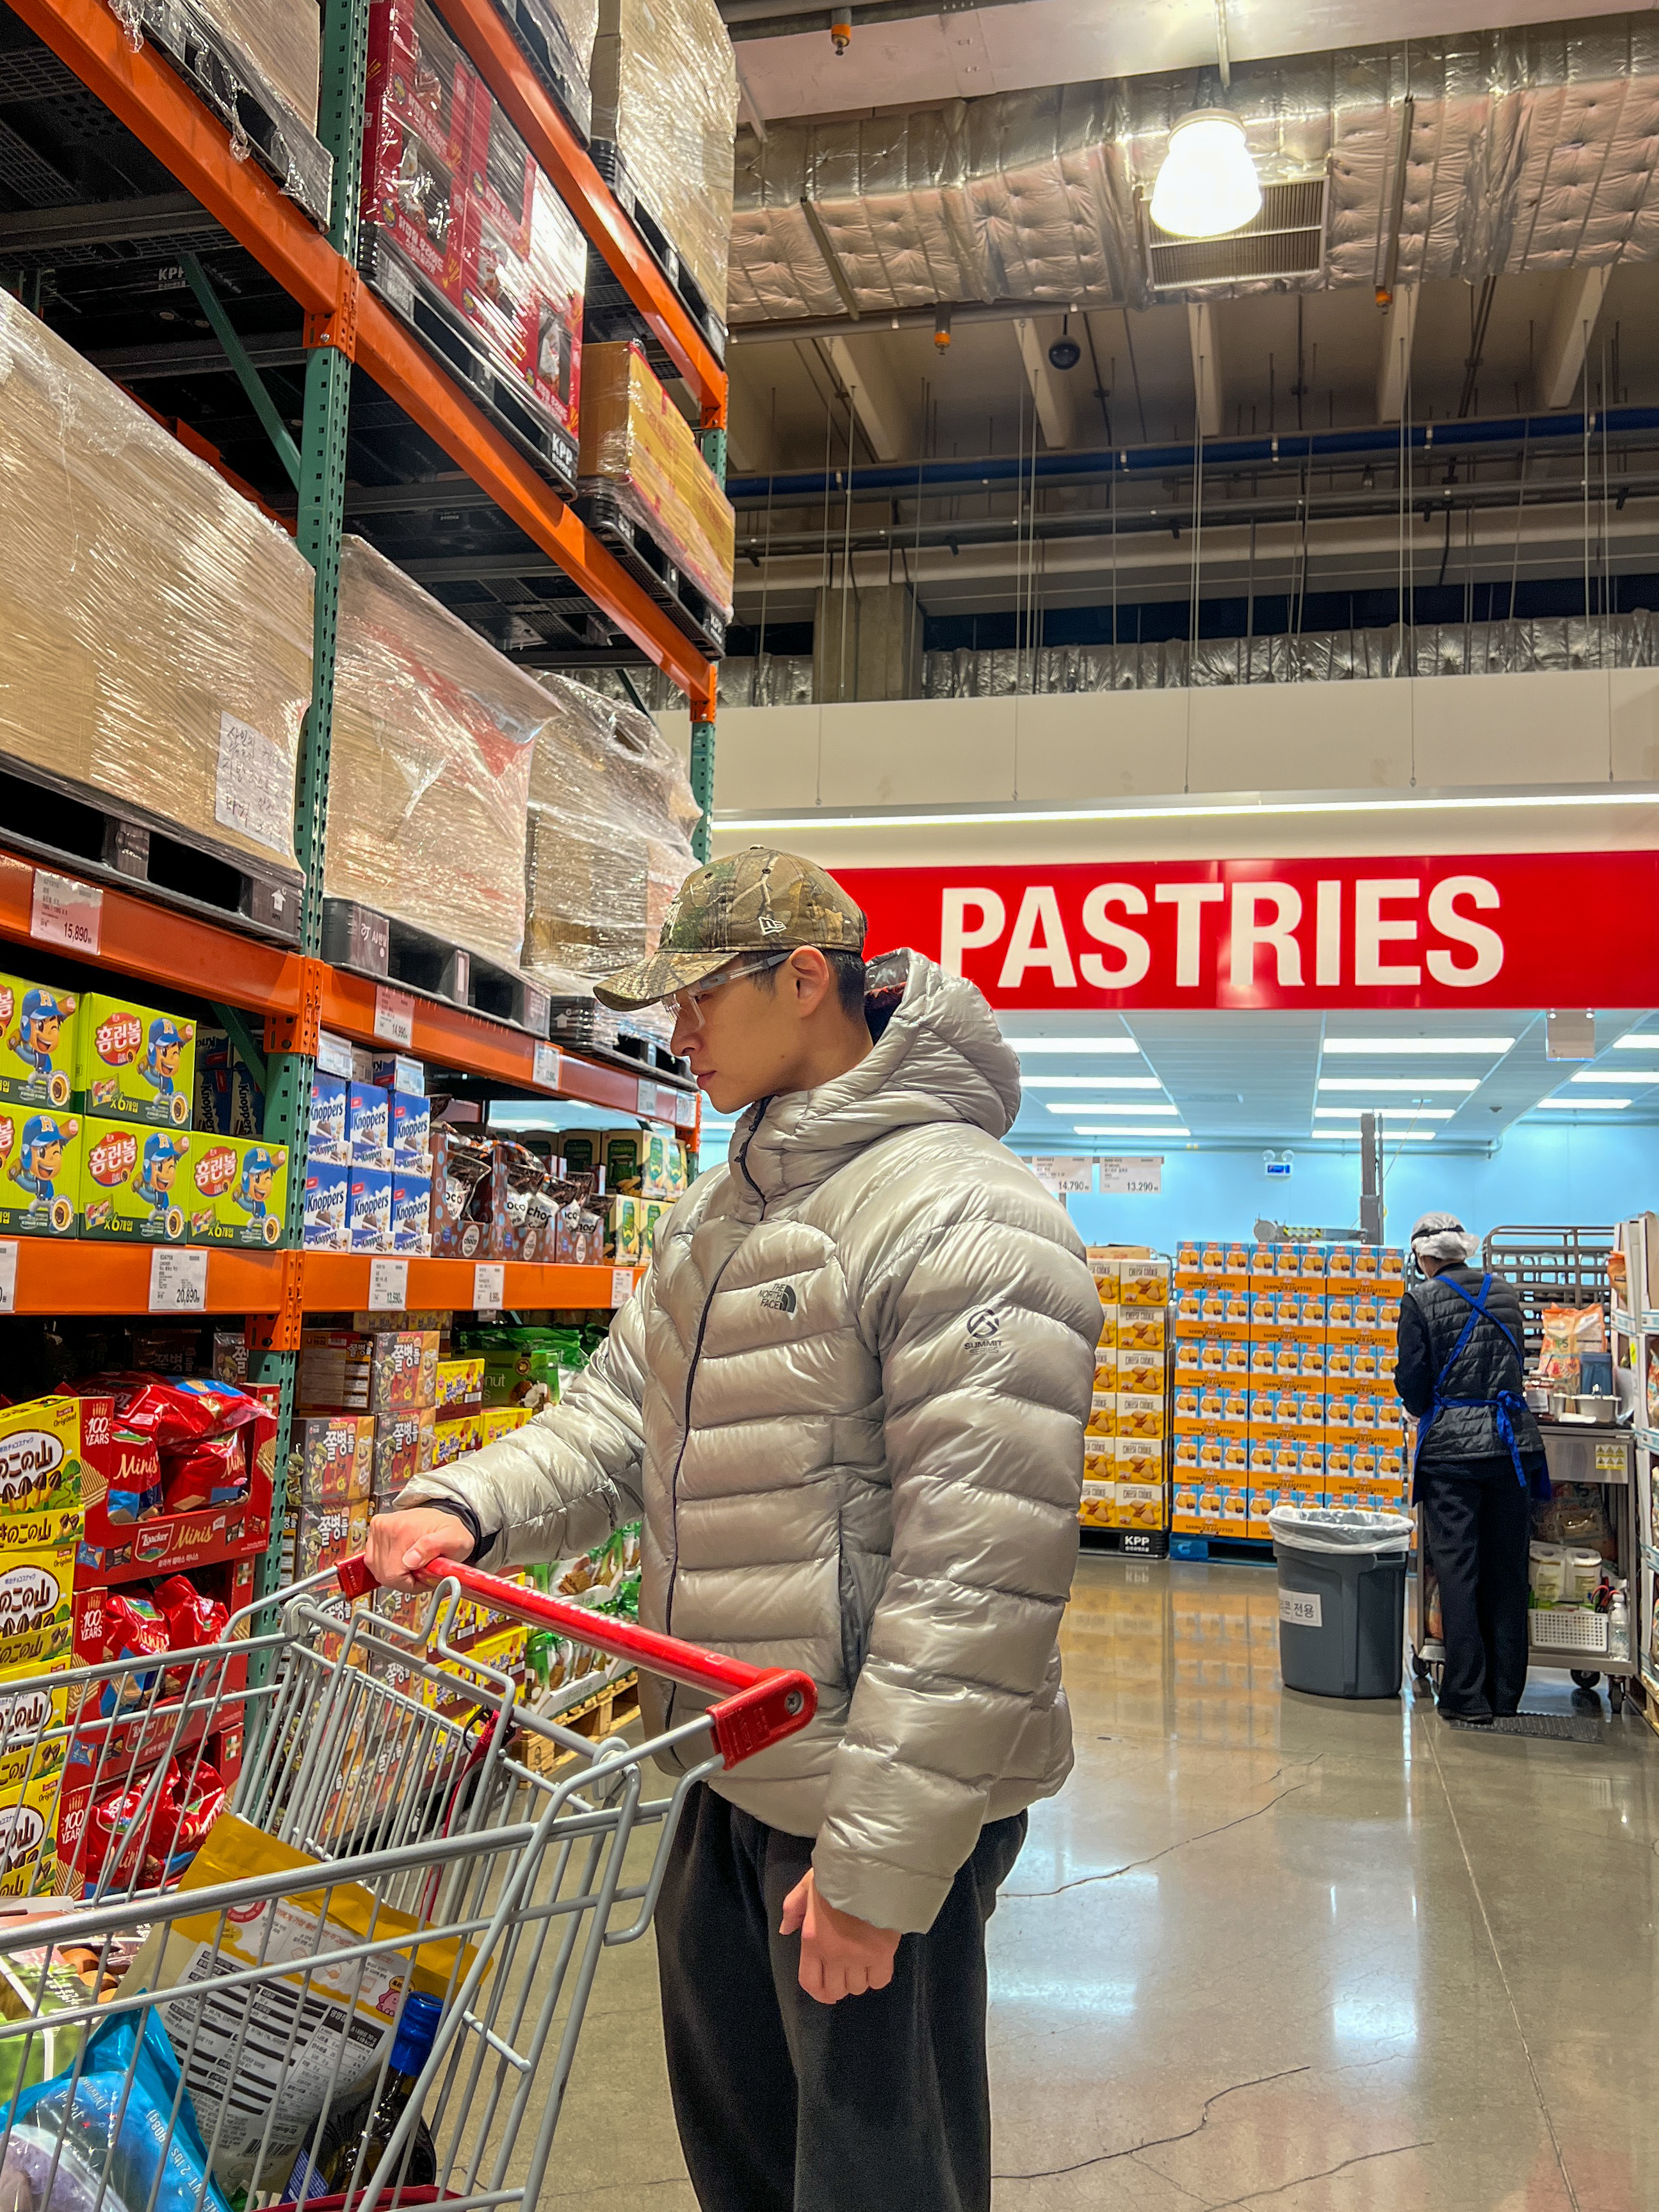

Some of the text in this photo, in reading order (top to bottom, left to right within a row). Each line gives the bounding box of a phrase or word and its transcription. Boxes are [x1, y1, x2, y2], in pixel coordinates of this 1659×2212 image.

[552, 432, 572, 465] KPP
[940, 875, 1504, 989] PASTRIES
[96, 1019, 142, 1053] 홈런볼
[353, 1111, 385, 1130] Knoppers
[397, 1120, 428, 1139] Knoppers
[89, 1137, 137, 1174] 홈런볼
[316, 1143, 337, 1156] Knoppers
[361, 1150, 382, 1162] Knoppers
[194, 1150, 237, 1186] 홈런볼
[403, 1156, 423, 1168] Knoppers
[307, 1191, 344, 1213] Knoppers
[354, 1195, 389, 1216] Knoppers
[396, 1200, 427, 1221] Knoppers
[314, 1231, 337, 1245] Knoppers
[361, 1234, 383, 1248] Knoppers
[1129, 1266, 1158, 1277] CHEESE COOKIE
[758, 1289, 783, 1300] NORTH
[772, 1283, 786, 1292] THE
[760, 1298, 781, 1310] FACE
[1126, 1311, 1154, 1321] CHEESE COOKIE
[964, 1340, 1002, 1350] SUMMIT
[969, 1346, 999, 1355] SERIES
[391, 1343, 421, 1373] 쫄병들
[1125, 1355, 1154, 1366] CHEESE COOKIE
[1124, 1400, 1153, 1410] CHEESE COOKIE
[53, 1412, 77, 1428] Original
[88, 1417, 109, 1434] 100
[85, 1433, 109, 1446] YEARS
[392, 1421, 419, 1451] 쫄병들
[323, 1429, 355, 1462] 쫄병들
[1122, 1444, 1152, 1455] CHEESE COOKIE
[0, 1439, 53, 1478] のこの山
[113, 1454, 158, 1480] Minis
[220, 1455, 245, 1480] Mini
[1123, 1490, 1152, 1499] CHEESE COOKIE
[283, 1514, 297, 1530] 병들
[317, 1514, 349, 1547] 쫄병들
[142, 1531, 169, 1547] Loacker
[171, 1524, 214, 1551] Minis
[1124, 1535, 1150, 1546] KPP
[0, 1578, 51, 1612] のこの山
[83, 1609, 101, 1627] 100
[1293, 1602, 1315, 1619] 전용
[80, 1624, 103, 1642] YEARS
[0, 1635, 44, 1664] のこの山
[65, 1808, 85, 1830] 100
[145, 2109, 166, 2147] 908g)
